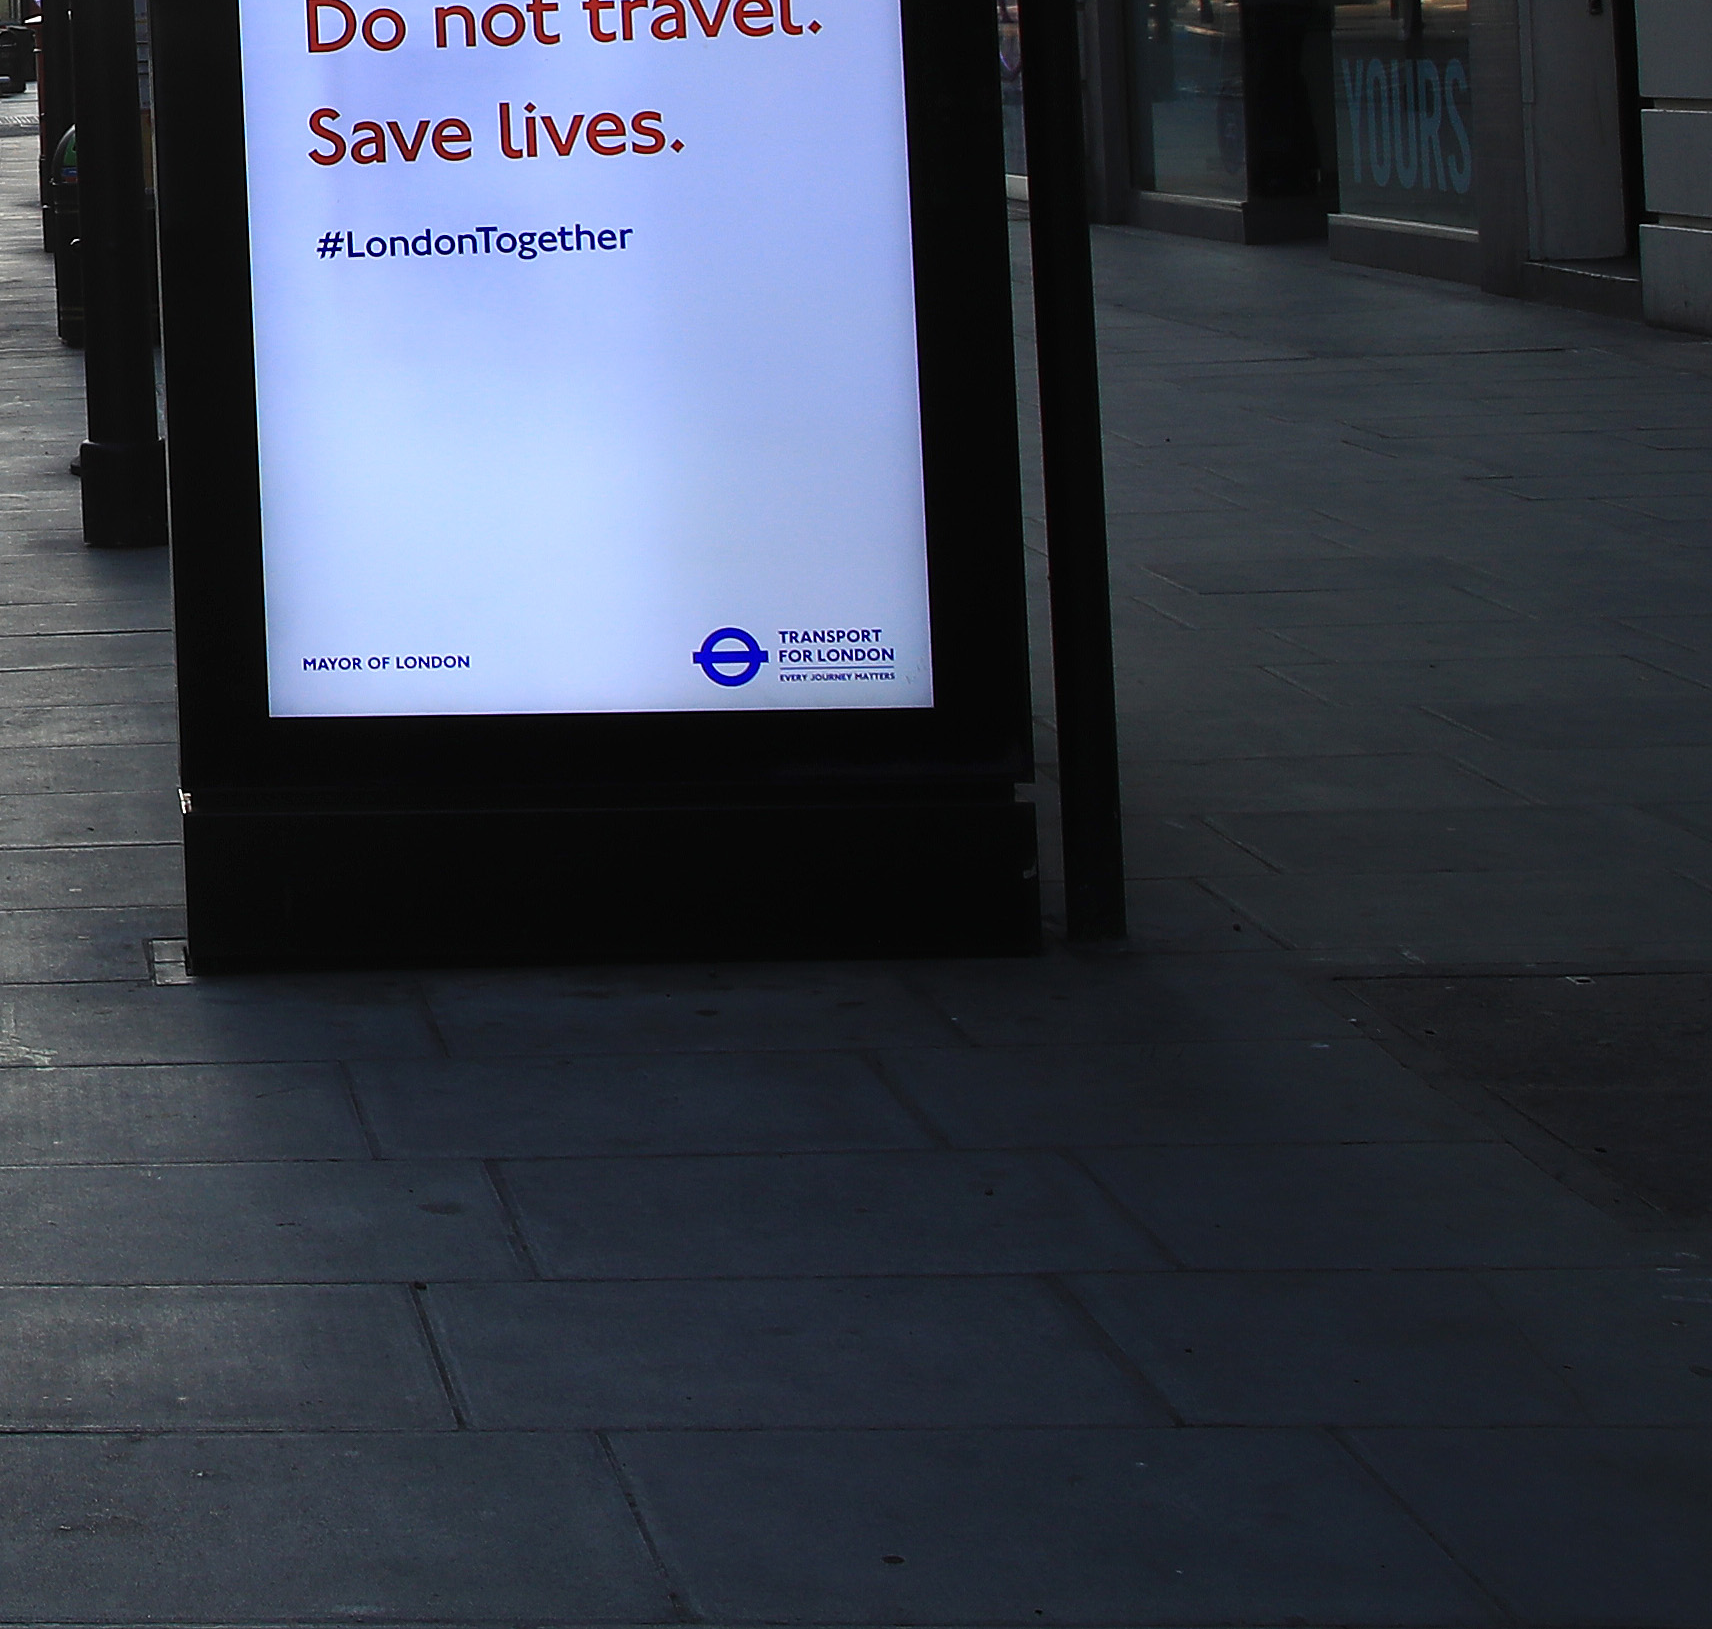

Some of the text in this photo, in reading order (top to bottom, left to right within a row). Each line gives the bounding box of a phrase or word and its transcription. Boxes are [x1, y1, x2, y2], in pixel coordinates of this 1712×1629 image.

[308, 102, 685, 166] Save lives.
[1340, 58, 1472, 195] YOURS
[316, 224, 634, 260] #LondonTogether
[778, 629, 882, 644] TRANSPORT
[302, 655, 470, 671] MAYOR OF LONDON
[778, 648, 895, 663] FOR LONDON
[779, 672, 896, 682] EVERY JOURNEY MATTERS
